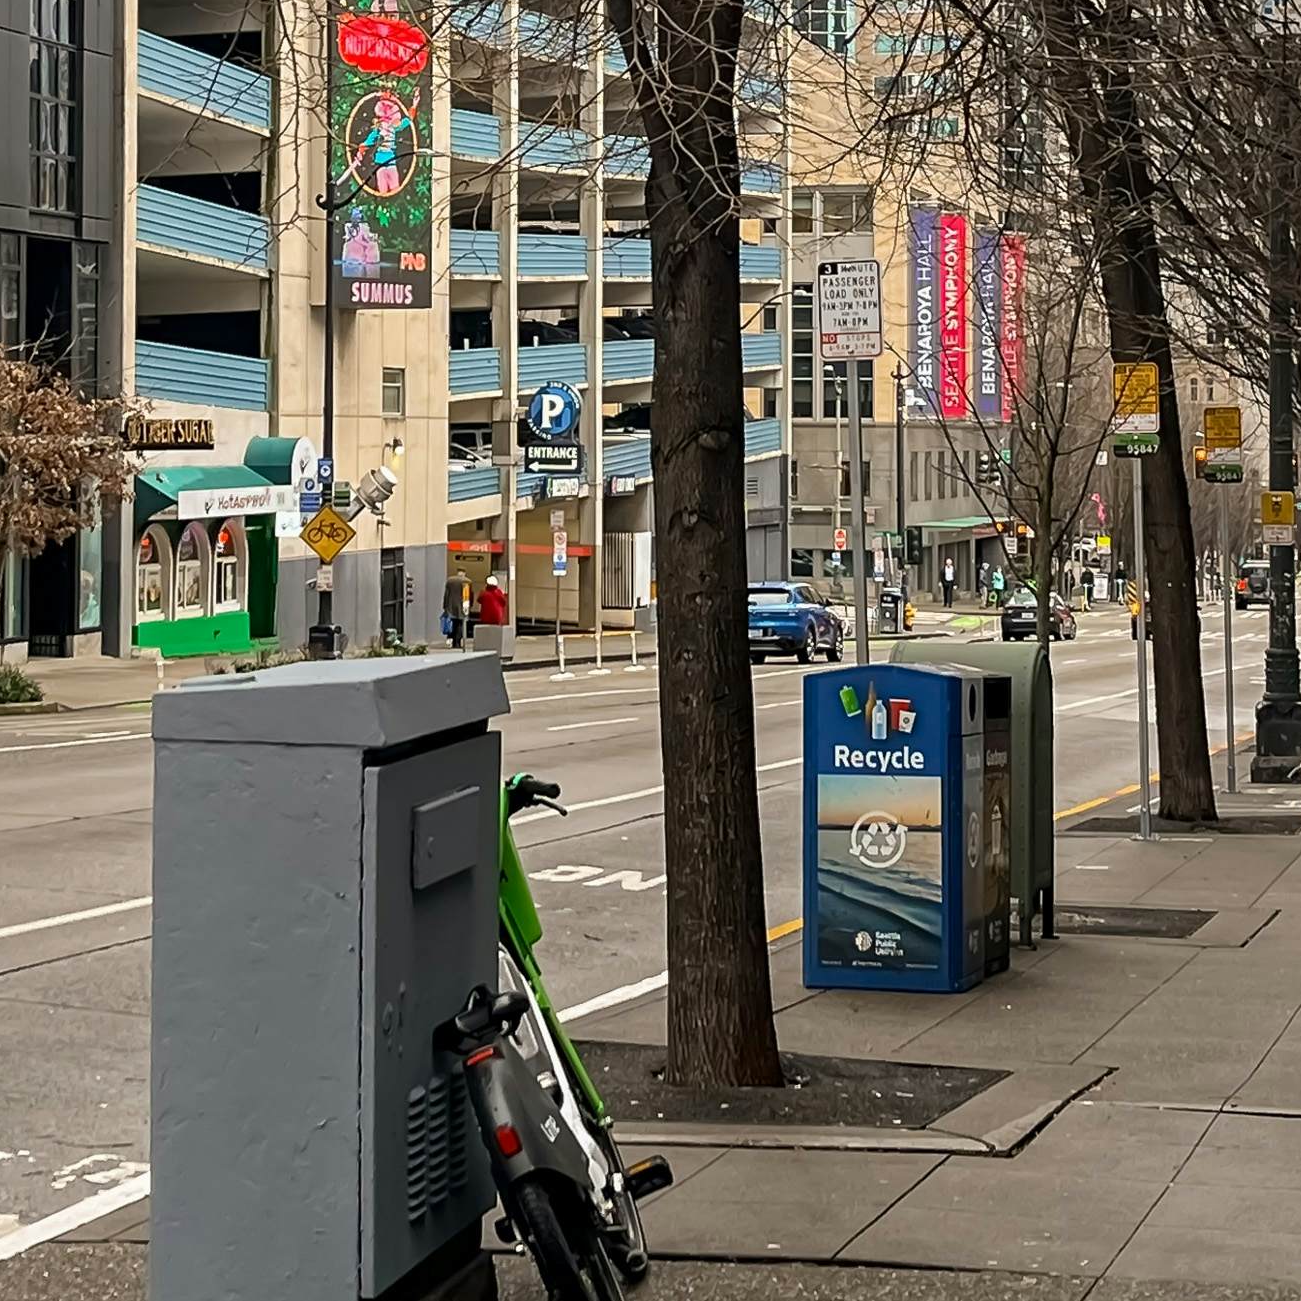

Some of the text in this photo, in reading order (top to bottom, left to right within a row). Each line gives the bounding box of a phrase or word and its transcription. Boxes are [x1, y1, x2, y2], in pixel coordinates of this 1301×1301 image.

[400, 252, 426, 271] PNB
[824, 264, 832, 275] 3
[822, 276, 876, 287] PASSENGER
[351, 282, 413, 305] SUMMUS
[824, 288, 874, 300] LOAD ONLY
[917, 234, 933, 388] BENAROYA HALL
[945, 226, 958, 408] SEATTLE SYMPHONY
[822, 334, 836, 343] NO
[541, 393, 565, 429] P
[528, 446, 578, 459] ENTRANCE
[1126, 444, 1159, 456] 95847
[834, 745, 925, 773] Recycle
